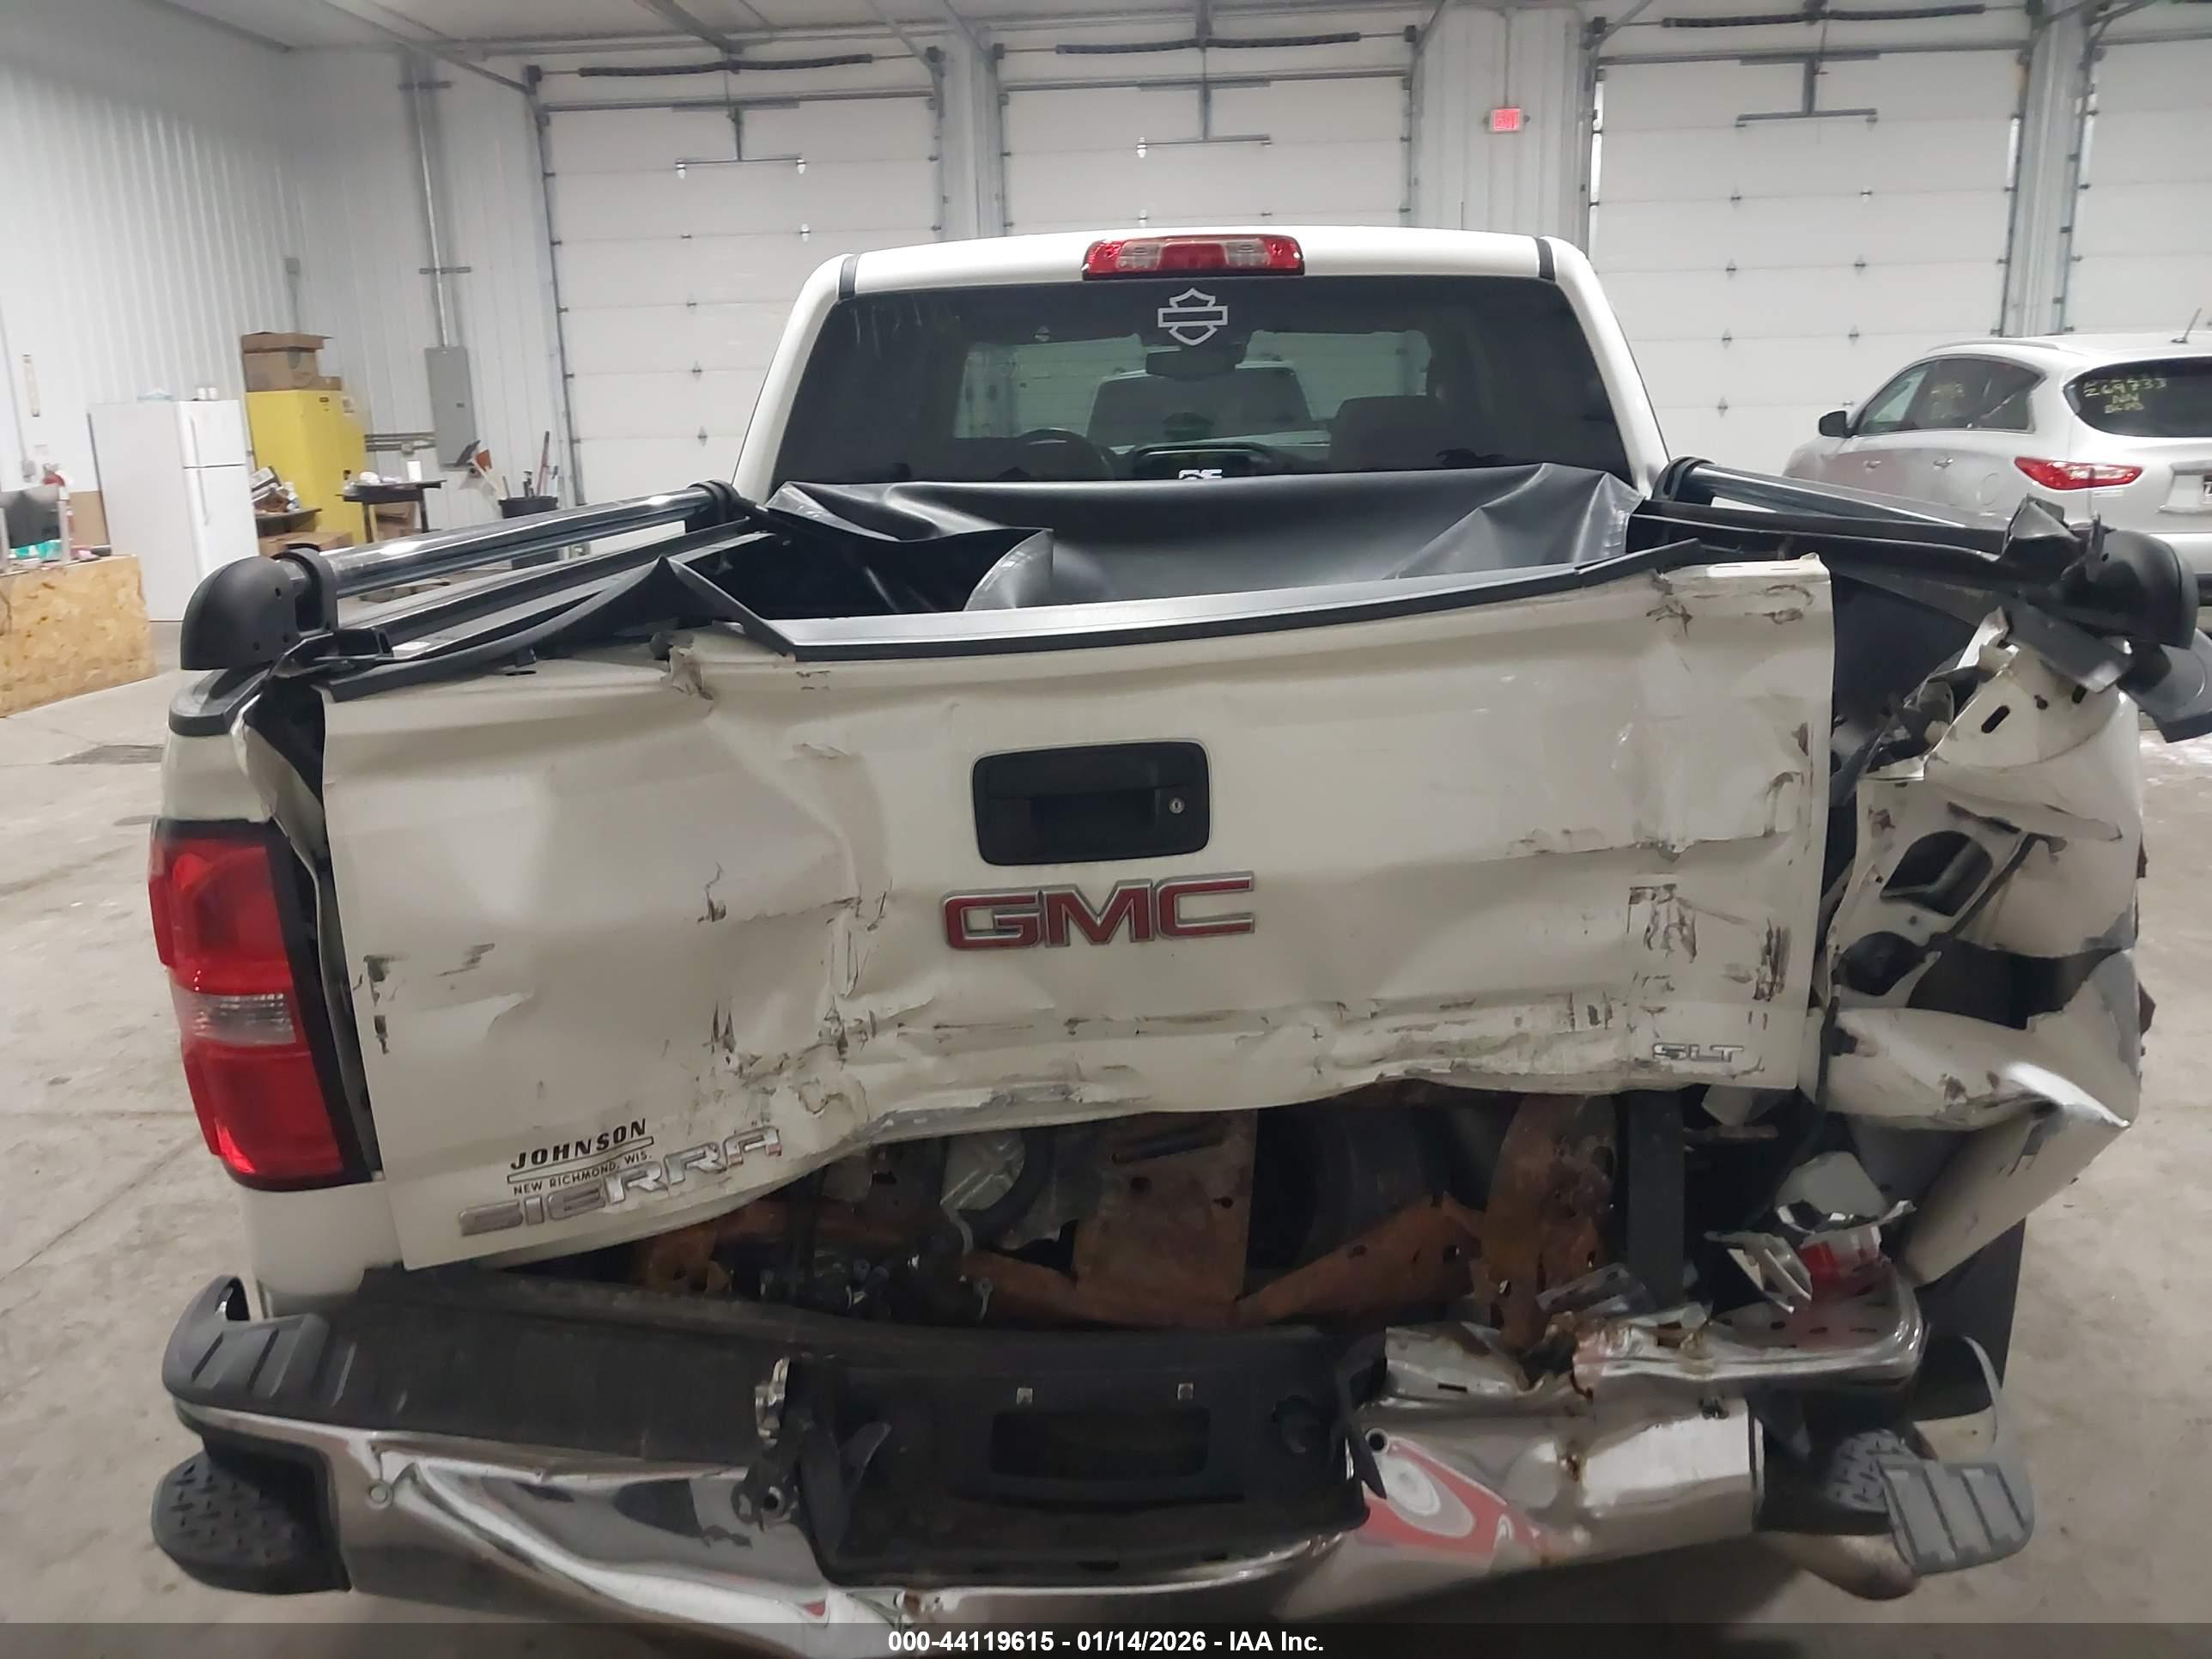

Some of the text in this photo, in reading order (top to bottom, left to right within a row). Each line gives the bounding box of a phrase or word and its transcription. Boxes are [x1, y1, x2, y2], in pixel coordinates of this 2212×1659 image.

[943, 872, 1255, 950] GMC
[1652, 1042, 1744, 1063] SLT
[510, 1118, 646, 1170] JOHNSON
[459, 1125, 784, 1237] SIERRA
[513, 1181, 543, 1195] NEW
[624, 1152, 652, 1165] WIS.
